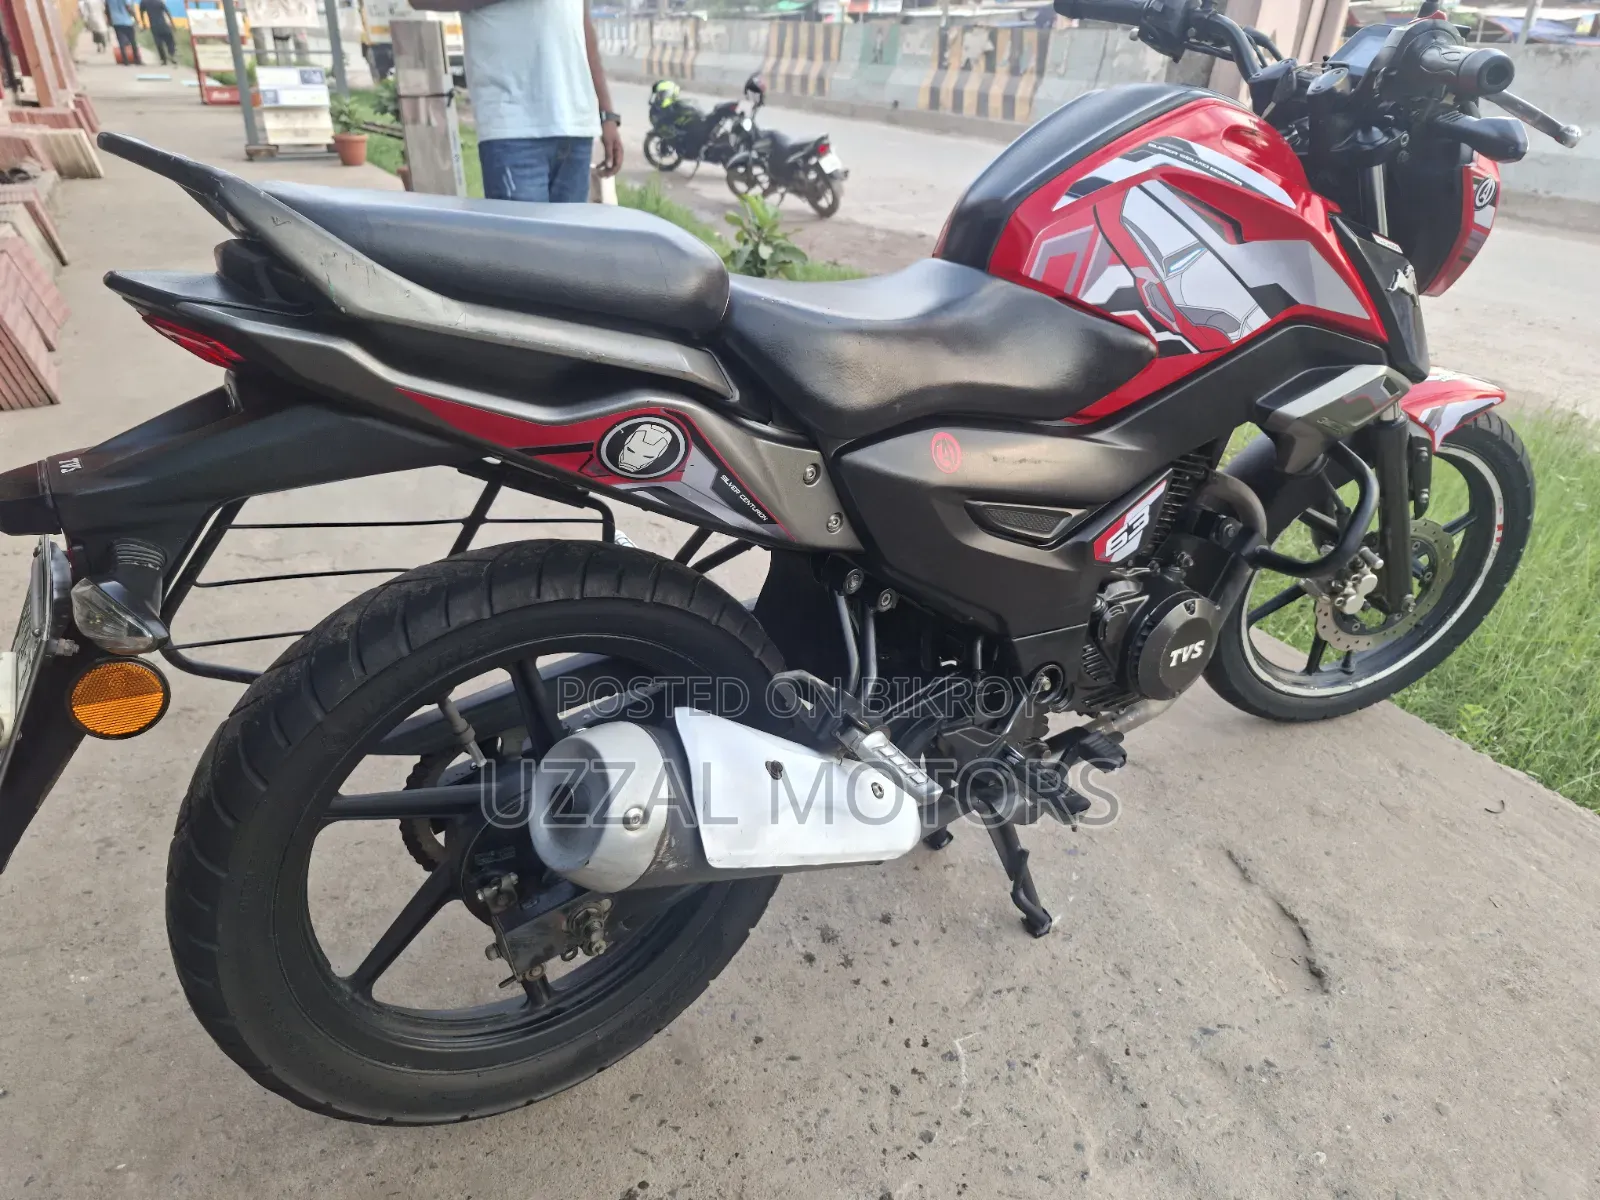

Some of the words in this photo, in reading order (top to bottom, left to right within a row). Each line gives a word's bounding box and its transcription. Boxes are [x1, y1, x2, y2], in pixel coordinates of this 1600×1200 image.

[720, 474, 741, 494] SILVER
[739, 494, 768, 521] CENTURION
[1169, 639, 1206, 667] TVS
